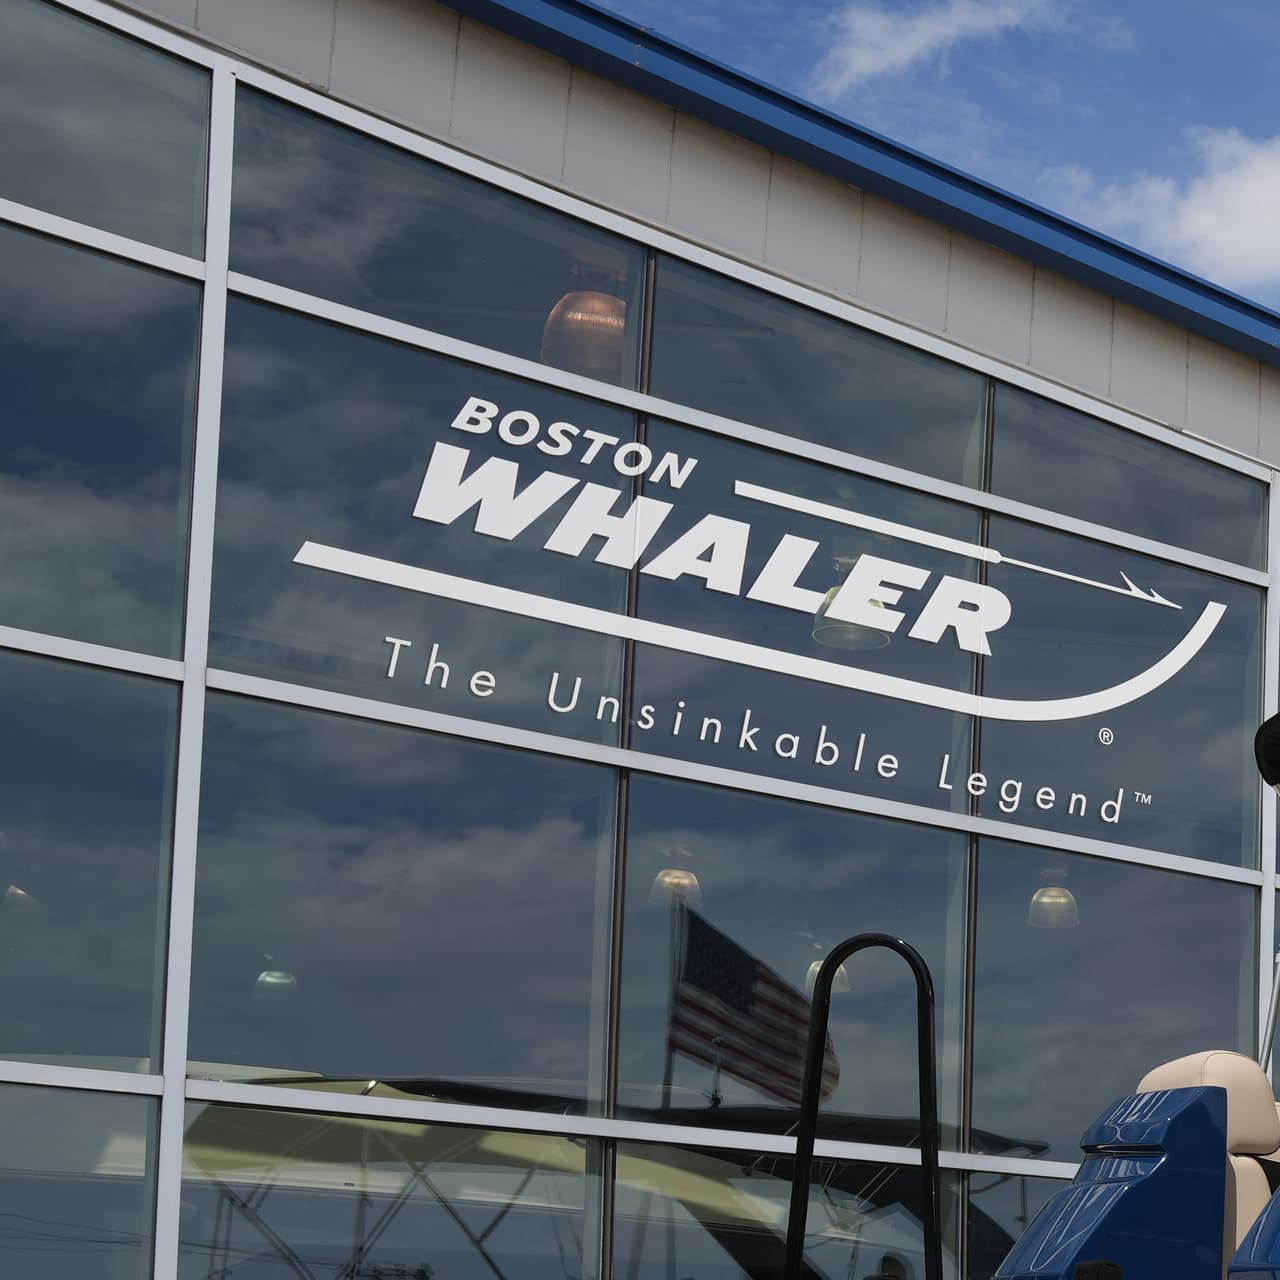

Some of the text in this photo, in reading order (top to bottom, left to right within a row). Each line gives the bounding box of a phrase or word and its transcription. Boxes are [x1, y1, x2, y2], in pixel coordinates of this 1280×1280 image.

[450, 396, 699, 489] BOSTON
[412, 441, 1013, 658] WHALER
[384, 636, 496, 697] The
[547, 671, 900, 778] Unsinkable
